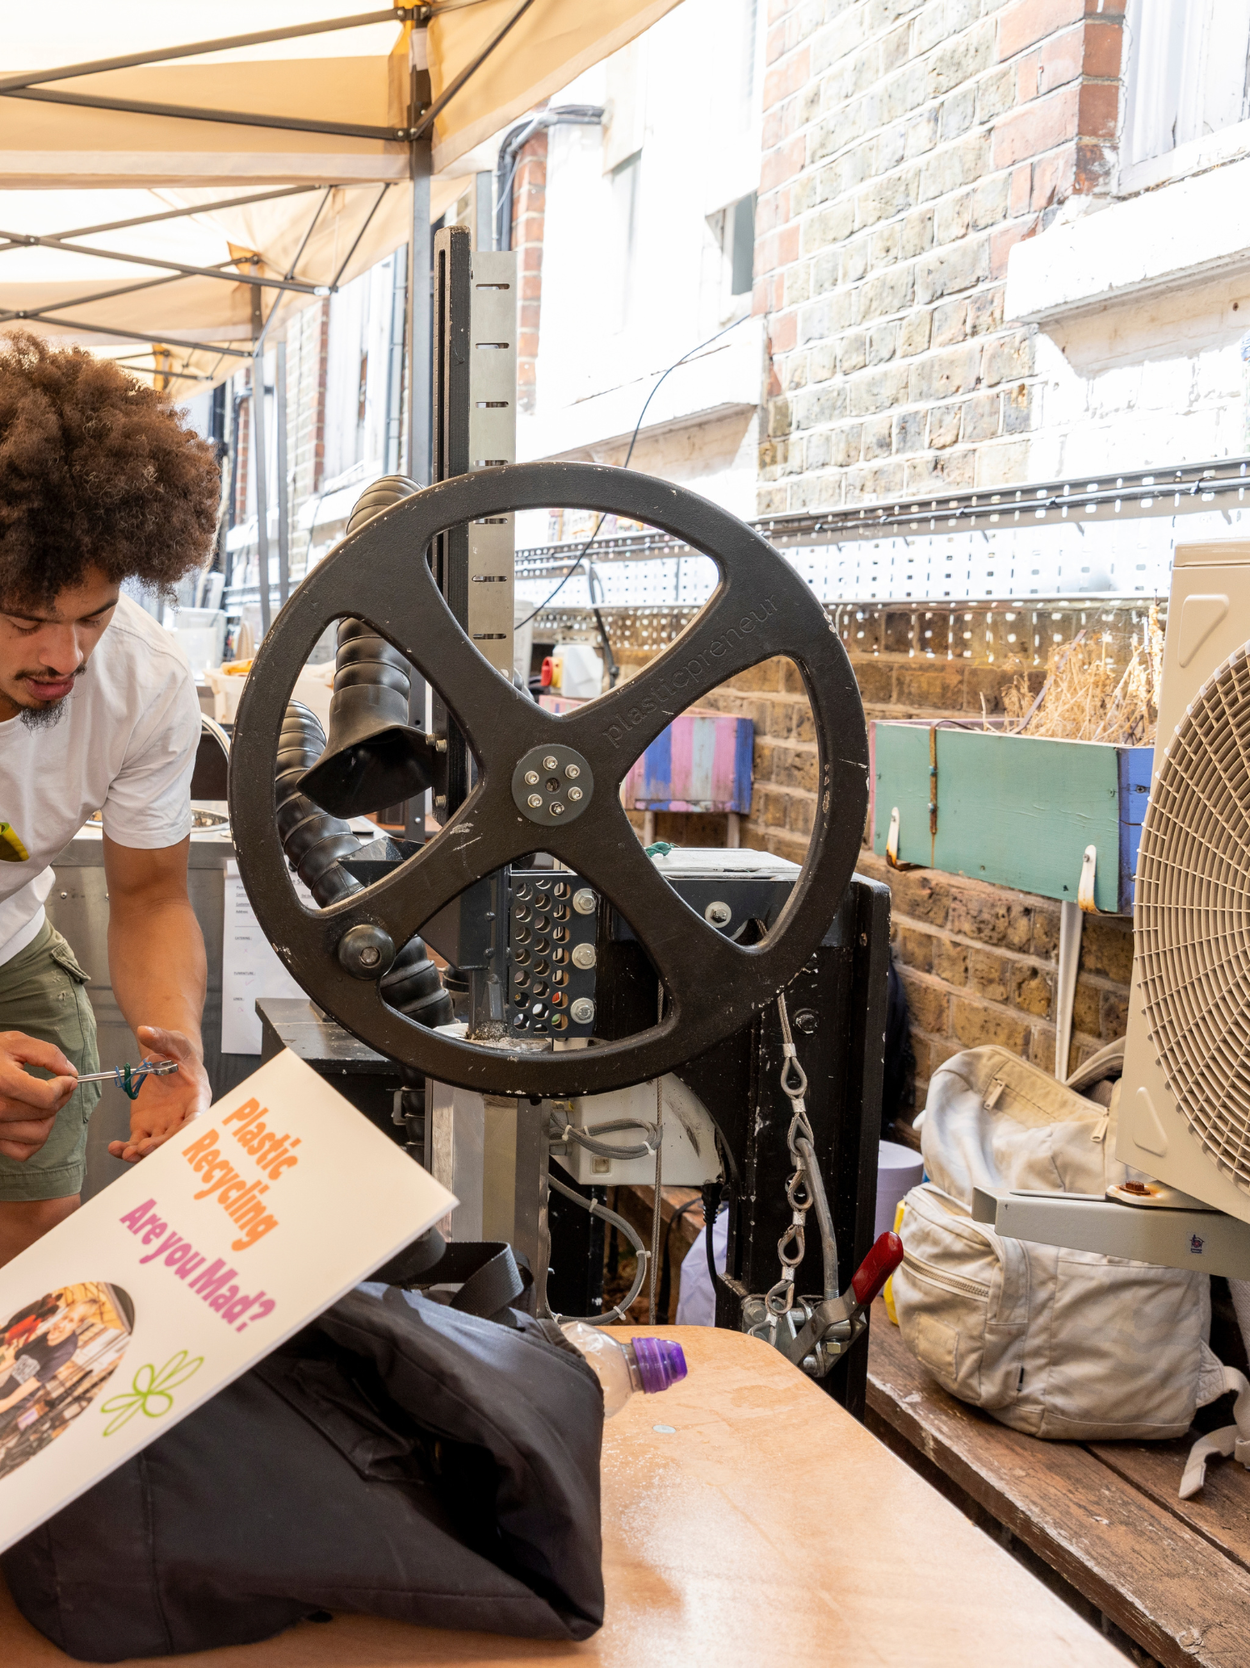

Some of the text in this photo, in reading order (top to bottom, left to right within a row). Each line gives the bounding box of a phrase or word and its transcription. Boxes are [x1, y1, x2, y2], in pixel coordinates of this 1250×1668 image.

[602, 593, 779, 749] plasticpreneur
[182, 1128, 279, 1251] Recycling
[222, 1097, 302, 1180] Plastic
[119, 1198, 276, 1333] Are you Mad?
